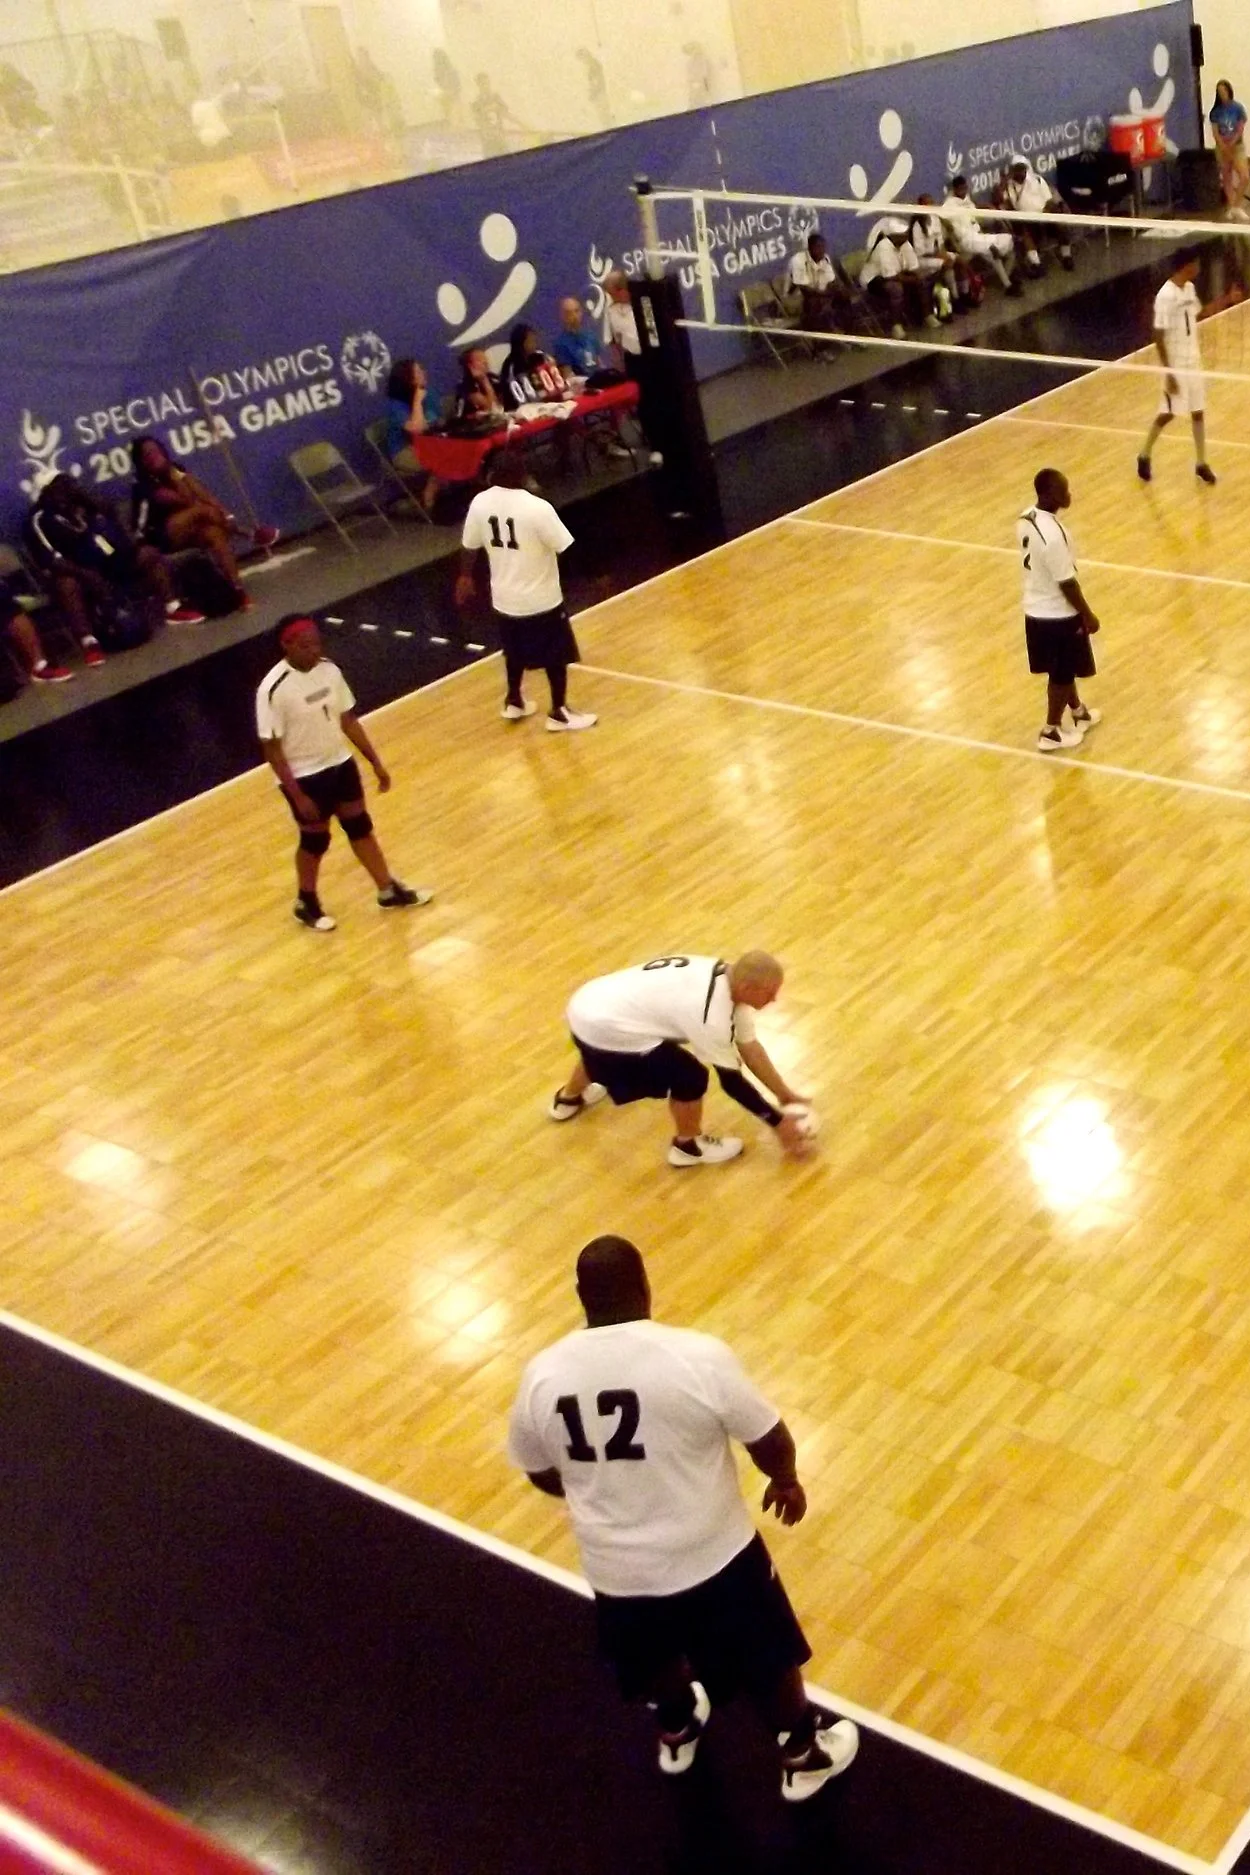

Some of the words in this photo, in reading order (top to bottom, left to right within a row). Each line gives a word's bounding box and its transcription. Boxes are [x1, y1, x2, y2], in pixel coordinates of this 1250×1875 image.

[968, 136, 1016, 168] SPECIAL
[1021, 119, 1080, 151] OLYMPICS
[723, 235, 787, 274] GAMES
[1184, 308, 1191, 336] 1
[75, 388, 194, 446] SPECIAL
[202, 345, 334, 405] OLYMPICS
[169, 414, 236, 456] USA
[239, 380, 343, 432] GAMES
[488, 515, 519, 550] 11
[555, 1388, 647, 1463] 12
